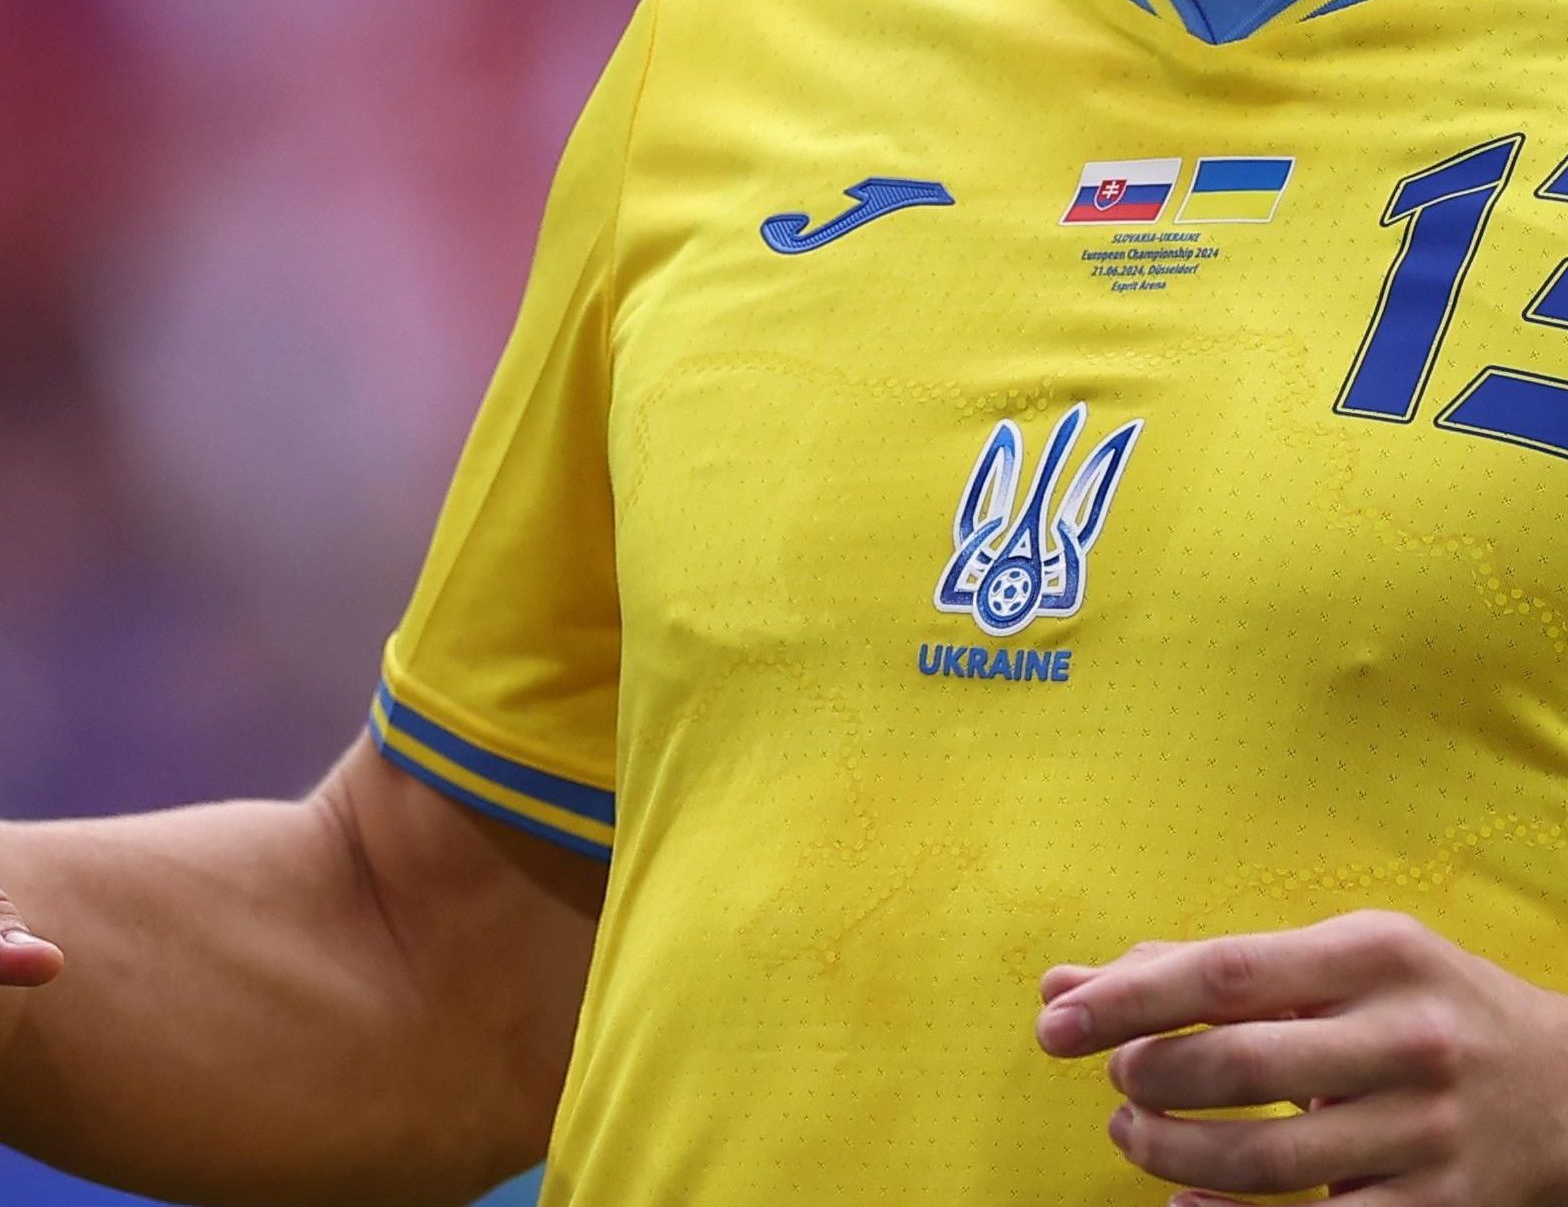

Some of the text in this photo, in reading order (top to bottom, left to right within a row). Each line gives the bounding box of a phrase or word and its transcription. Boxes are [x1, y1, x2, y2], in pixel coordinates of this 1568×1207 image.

[1081, 247, 1219, 261] European Championship 2024
[1147, 263, 1200, 275] Düsseldorf
[1111, 280, 1167, 293] Esprit Arena
[918, 644, 1073, 682] UKRAINE
